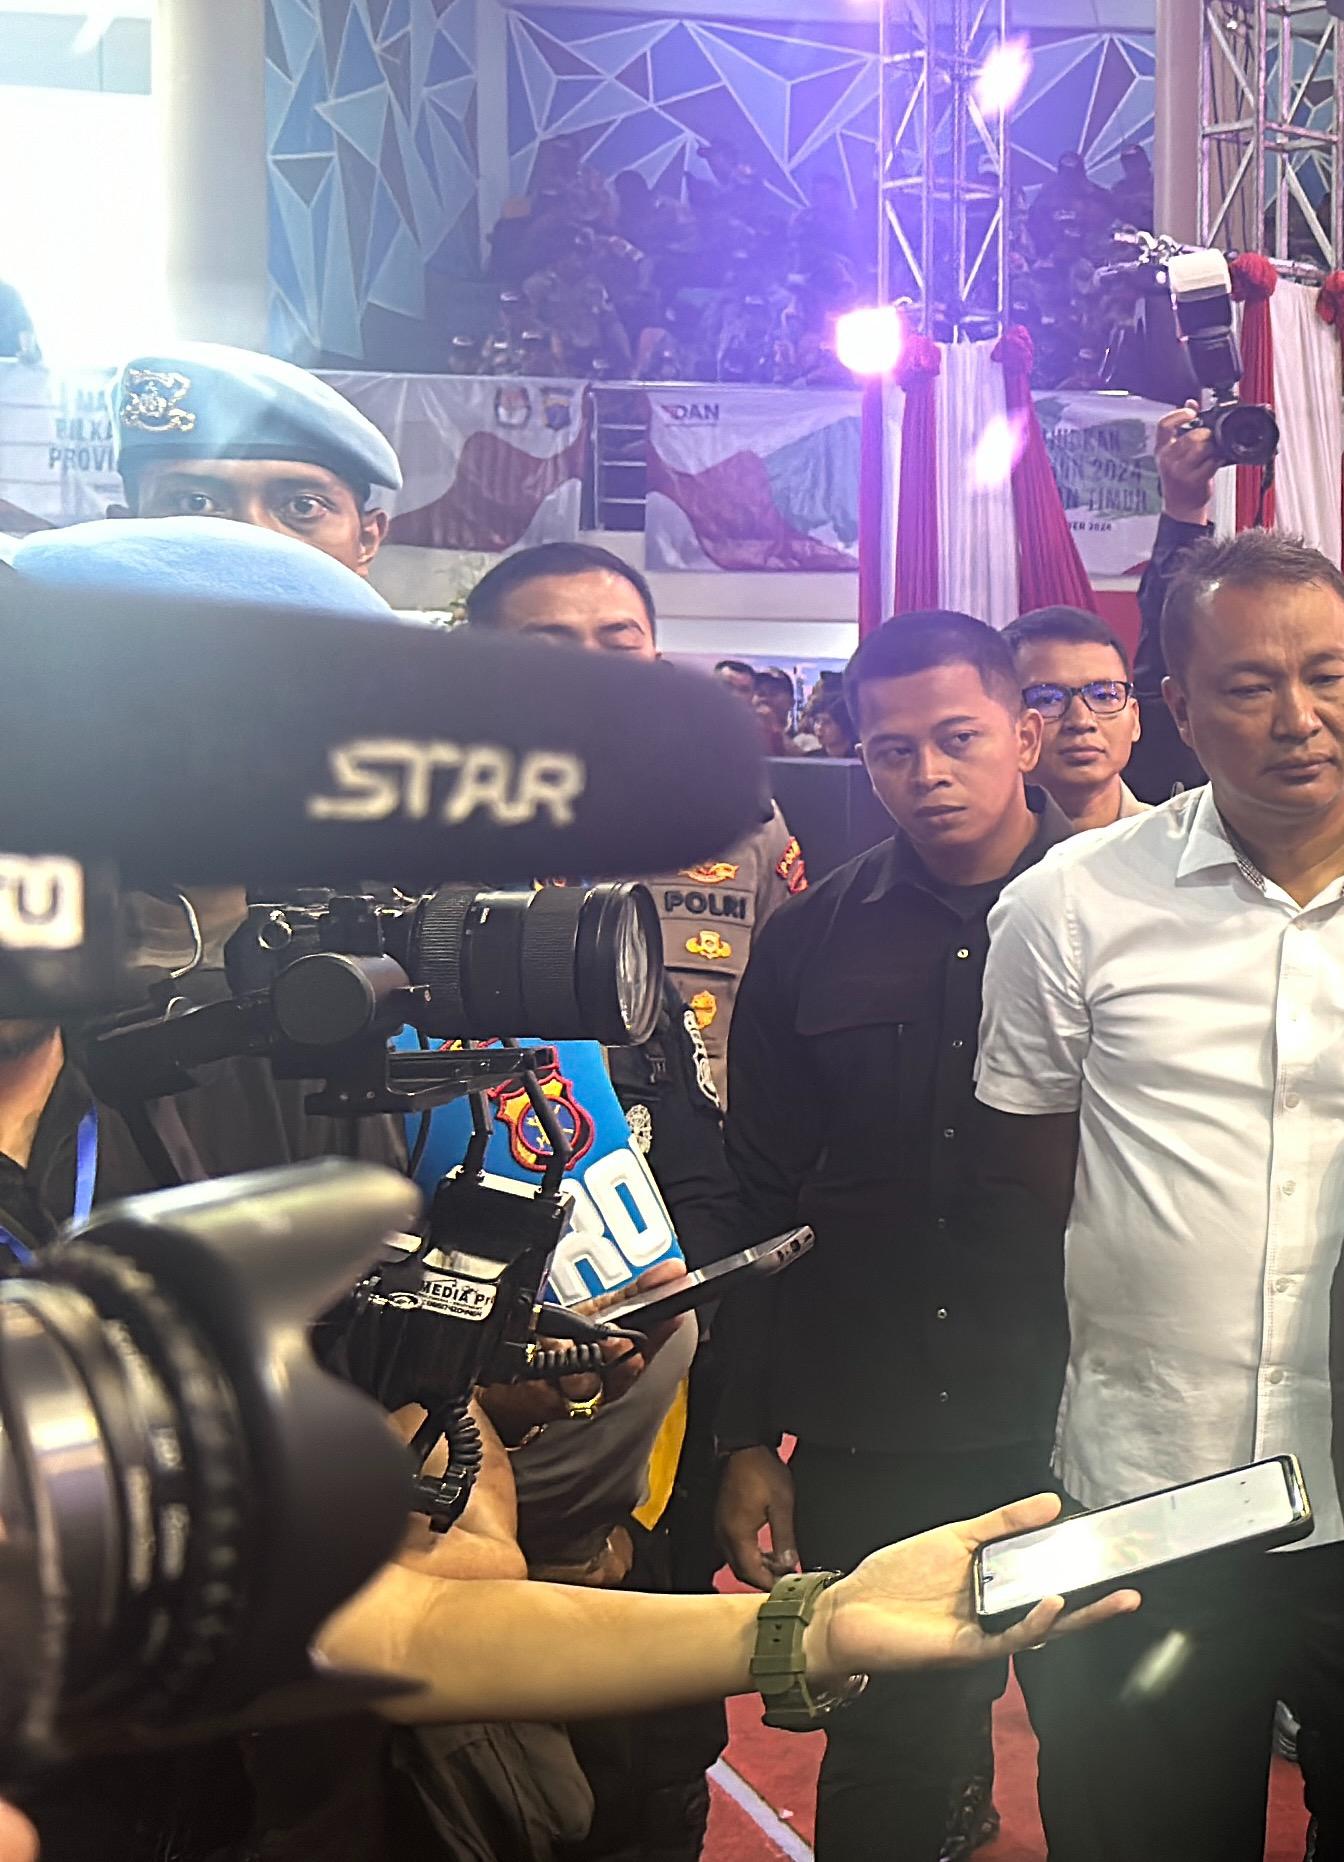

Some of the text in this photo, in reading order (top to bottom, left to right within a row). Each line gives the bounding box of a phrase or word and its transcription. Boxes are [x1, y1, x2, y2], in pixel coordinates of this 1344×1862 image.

[48, 447, 114, 471] PROVI
[306, 738, 587, 827] STAR
[664, 890, 746, 919] POLRI
[421, 1281, 468, 1303] MEDIA
